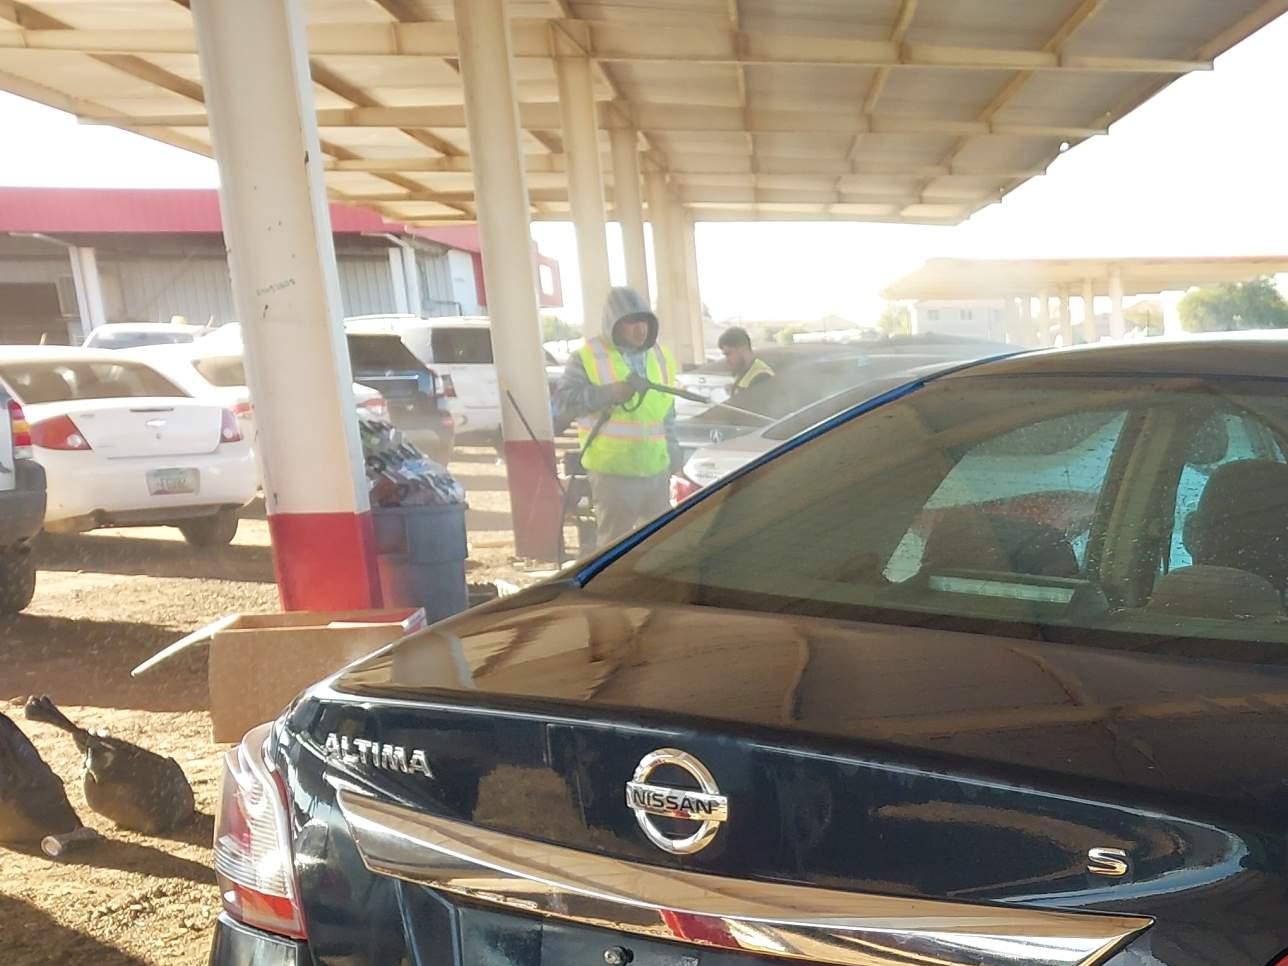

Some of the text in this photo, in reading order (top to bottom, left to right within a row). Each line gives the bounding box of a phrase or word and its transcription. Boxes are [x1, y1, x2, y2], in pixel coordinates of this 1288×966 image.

[321, 733, 434, 779] ALTIMA
[633, 790, 713, 815] NISSAN
[1088, 847, 1127, 876] S
